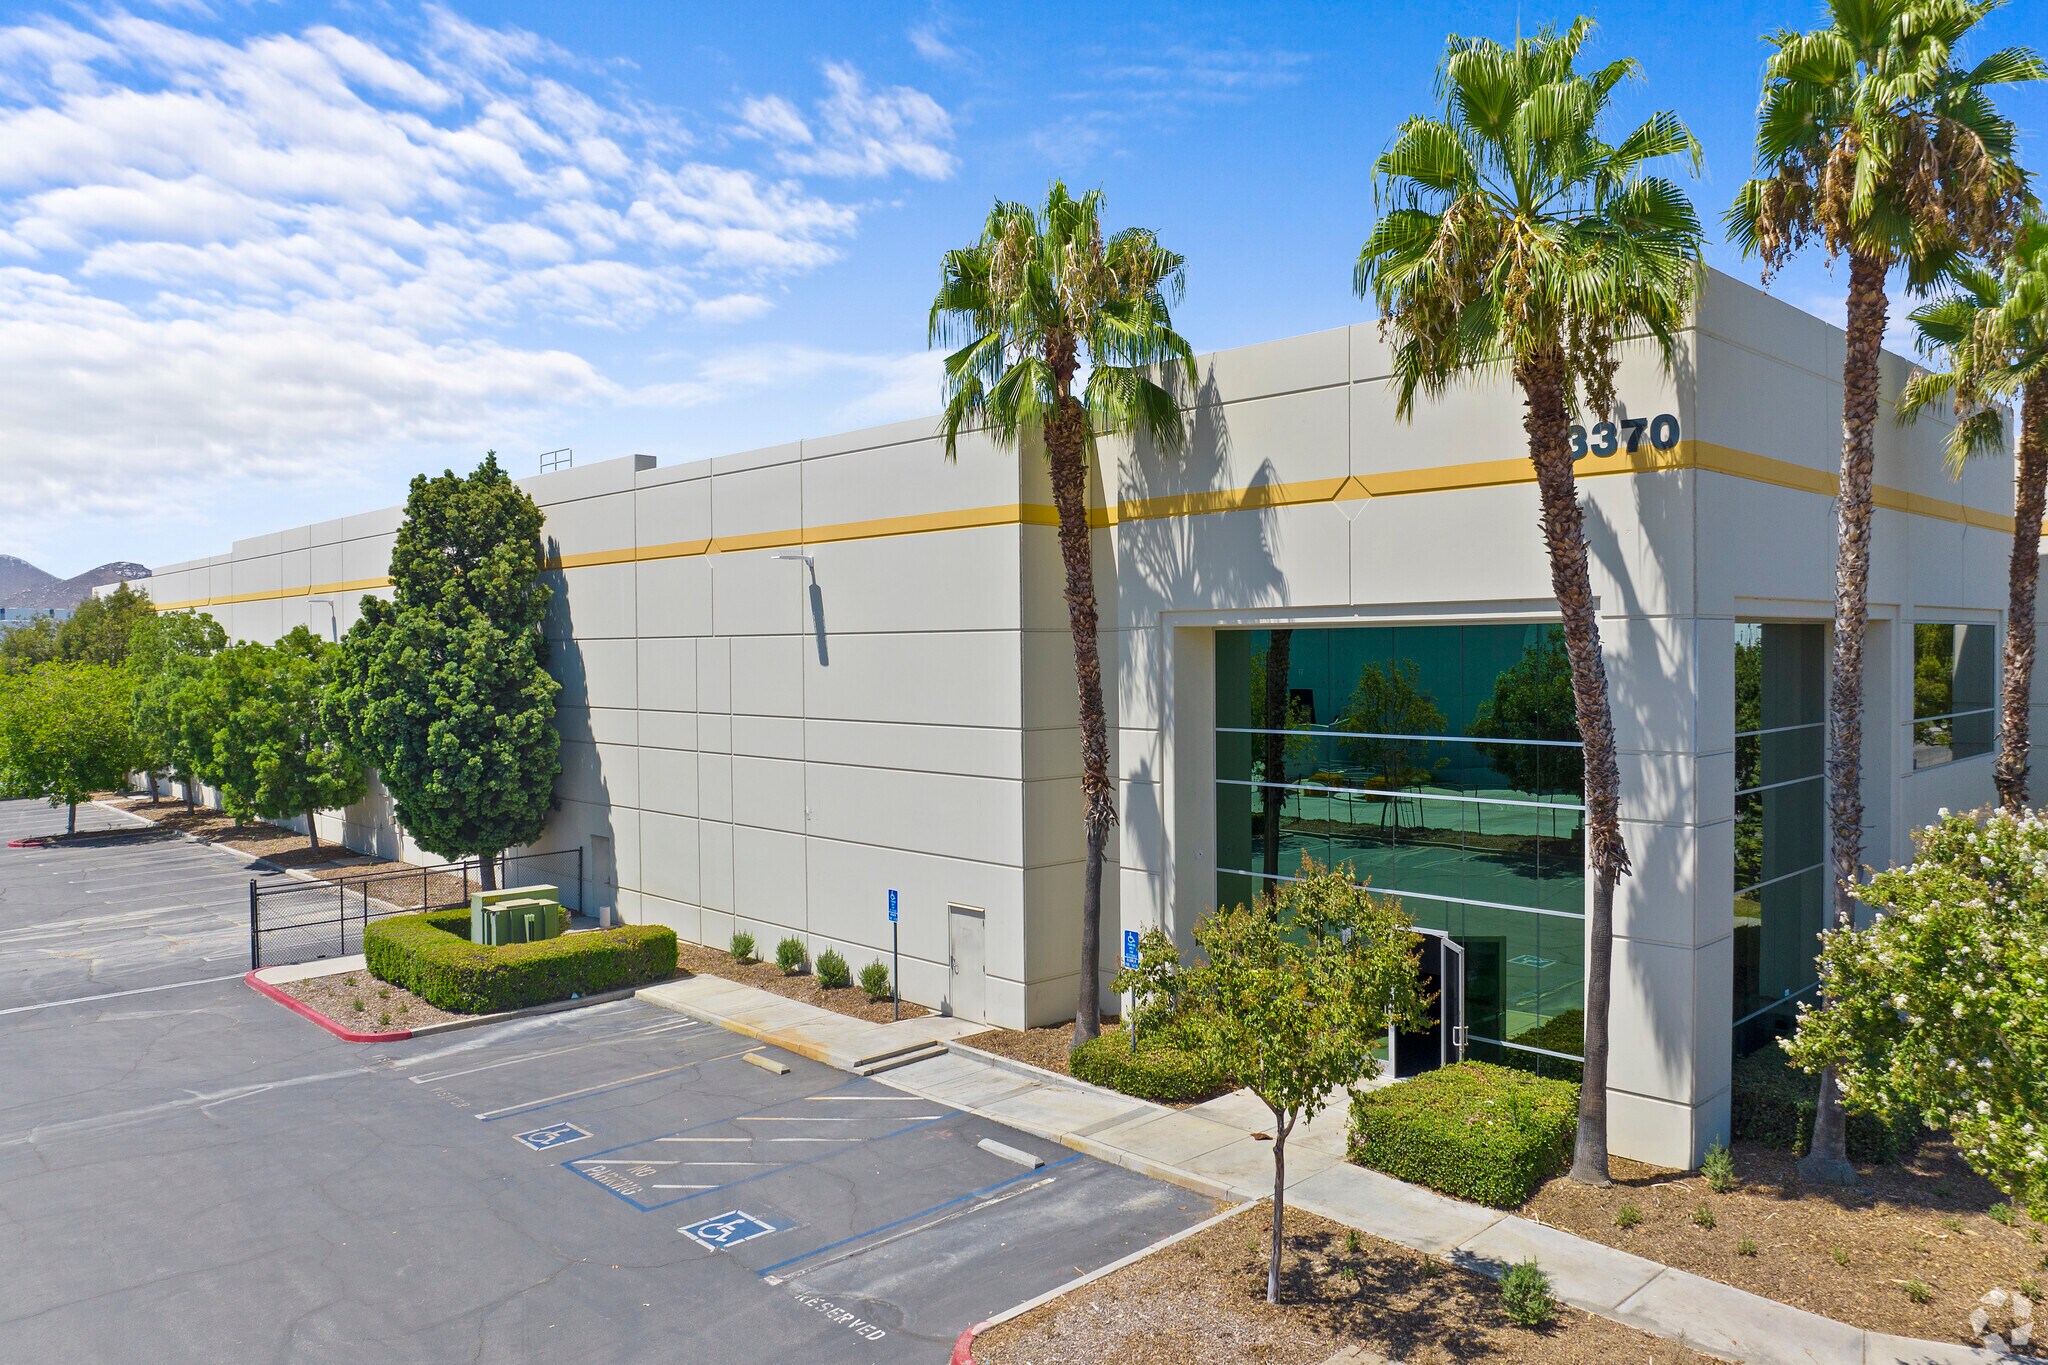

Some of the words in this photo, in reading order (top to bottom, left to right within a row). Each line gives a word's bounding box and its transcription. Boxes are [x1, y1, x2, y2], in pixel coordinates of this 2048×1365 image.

[1568, 413, 1680, 461] 3370
[582, 1164, 643, 1196] PARKING
[626, 1164, 657, 1178] NO
[794, 1290, 886, 1341] RESERVED
